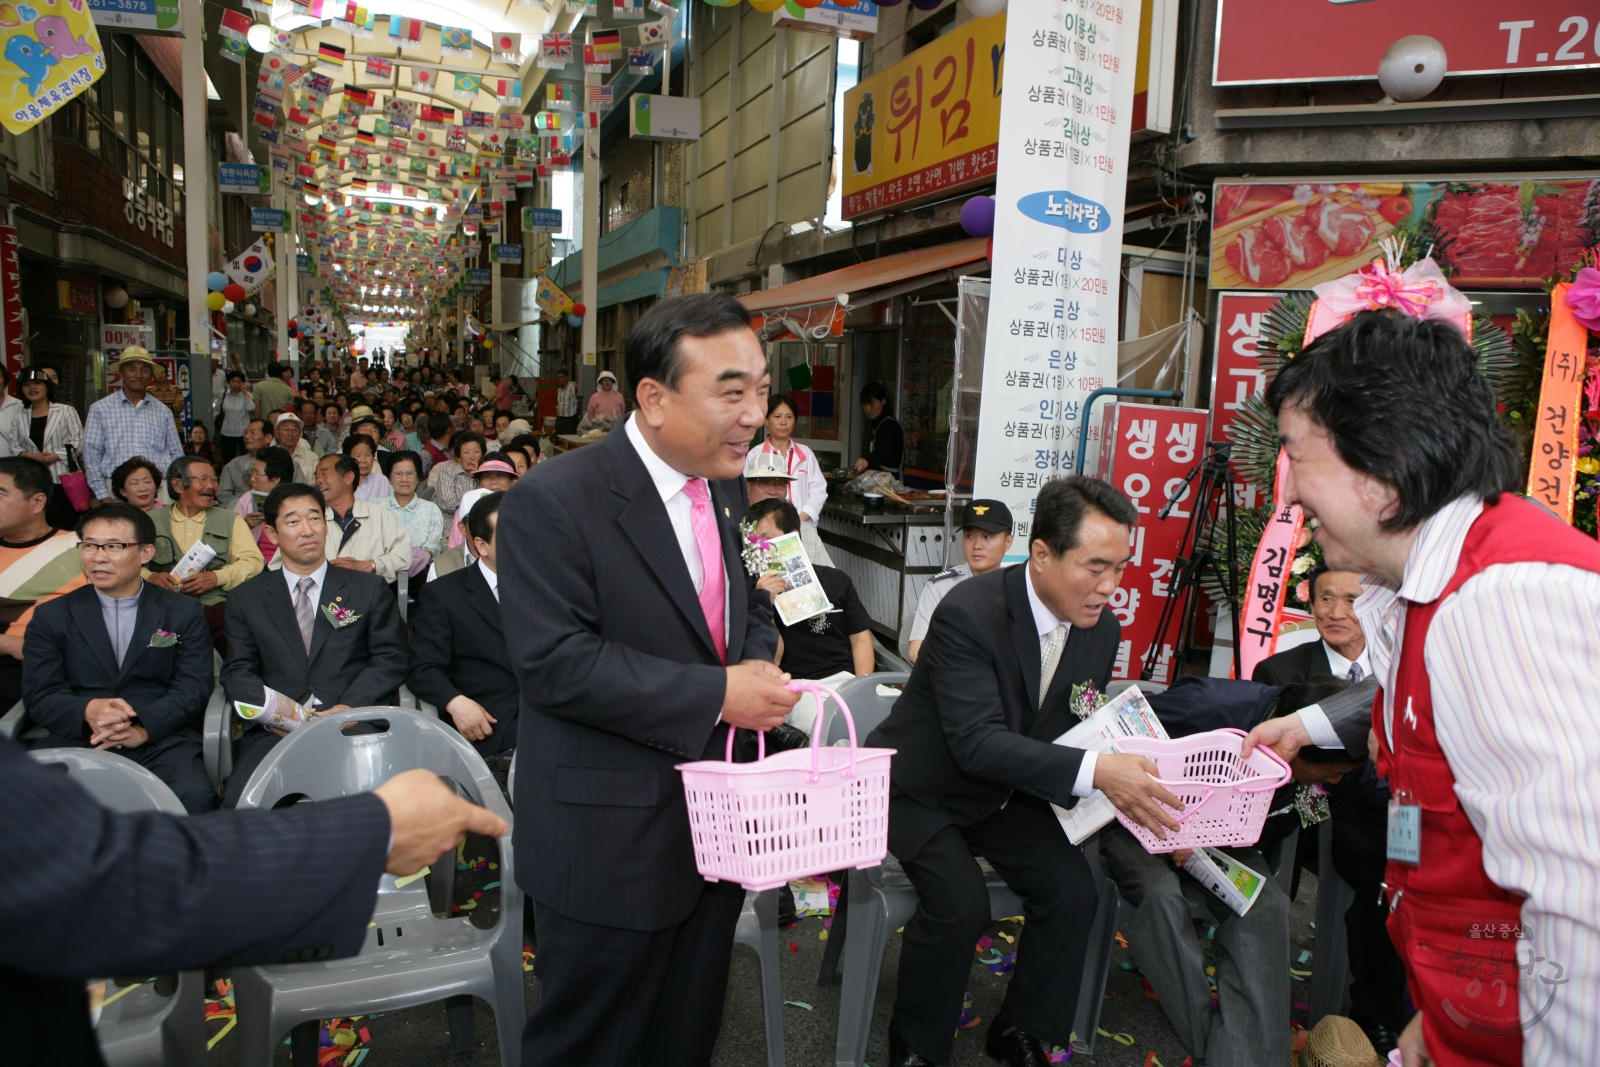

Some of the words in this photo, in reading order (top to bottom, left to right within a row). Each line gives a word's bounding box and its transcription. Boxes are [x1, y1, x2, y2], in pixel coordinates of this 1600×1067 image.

[1064, 13, 1098, 44] 이용상
[1498, 15, 1600, 64] T.2
[14, 67, 93, 122] 야음체육관시장
[1063, 66, 1094, 95] 고객상
[886, 37, 976, 164] 튀김
[1063, 117, 1091, 146] 감사상
[971, 150, 997, 174] 핫도그
[122, 176, 175, 248] 명동식육점
[1053, 298, 1080, 321] 금상
[1048, 349, 1077, 371] 은상
[1550, 350, 1577, 382] (주)
[1039, 399, 1079, 421] 인기상
[1536, 405, 1570, 514] 건양건
[1246, 547, 1288, 648] 김명구
